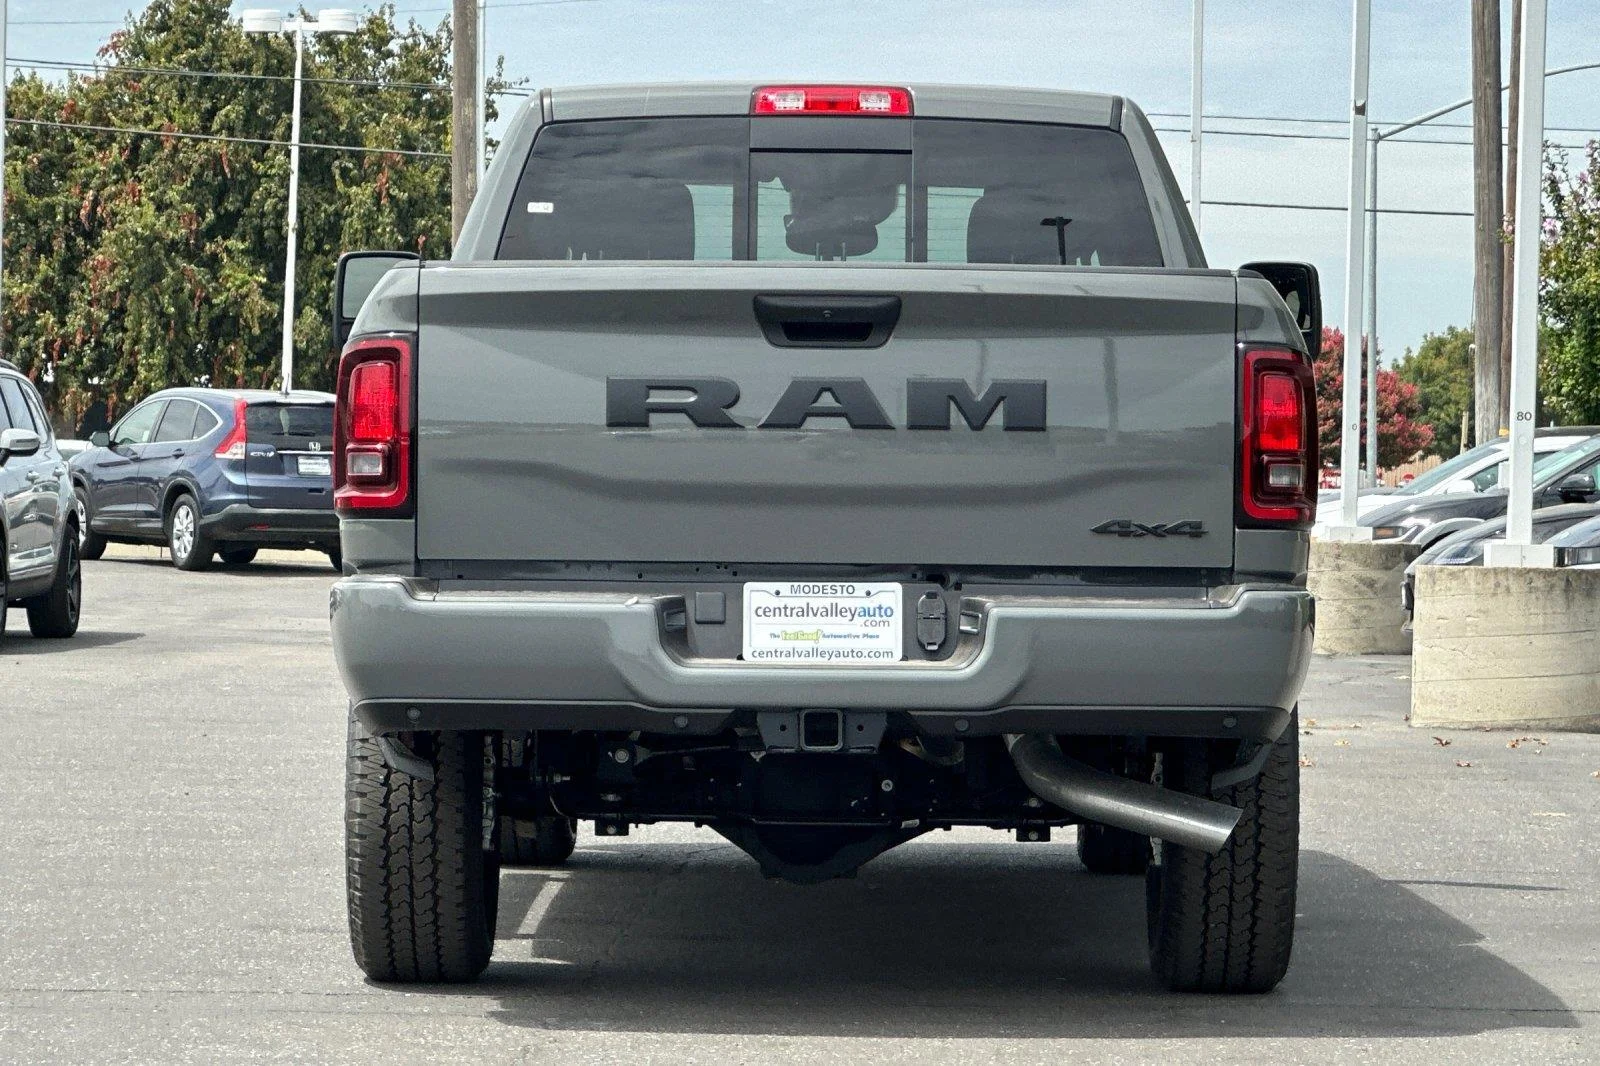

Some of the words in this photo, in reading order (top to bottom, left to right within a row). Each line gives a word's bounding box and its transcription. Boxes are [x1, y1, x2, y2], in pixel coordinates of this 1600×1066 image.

[606, 376, 1047, 431] RAM
[1516, 411, 1532, 421] 80
[1090, 519, 1208, 538] 4x4
[790, 584, 855, 595] MODESTO
[754, 602, 894, 622] centralvalleyauto
[859, 618, 891, 628] .com
[751, 647, 894, 661] centralvalleyauto.com
